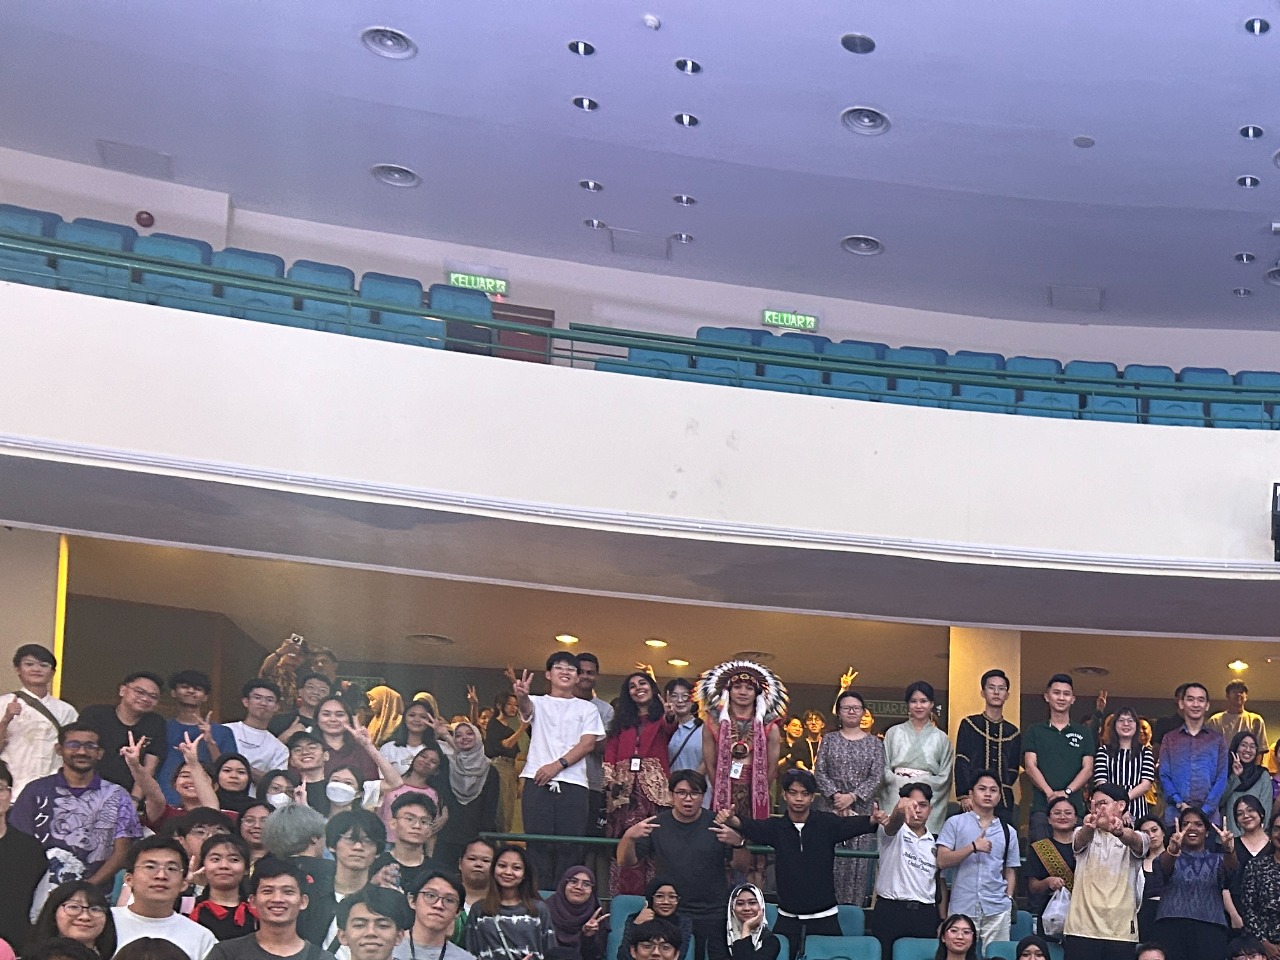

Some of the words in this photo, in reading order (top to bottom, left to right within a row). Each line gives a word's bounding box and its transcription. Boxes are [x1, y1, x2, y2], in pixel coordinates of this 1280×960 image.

[450, 273, 495, 292] KELUAR
[765, 310, 805, 327] KELUAR
[867, 702, 898, 714] ELUAR
